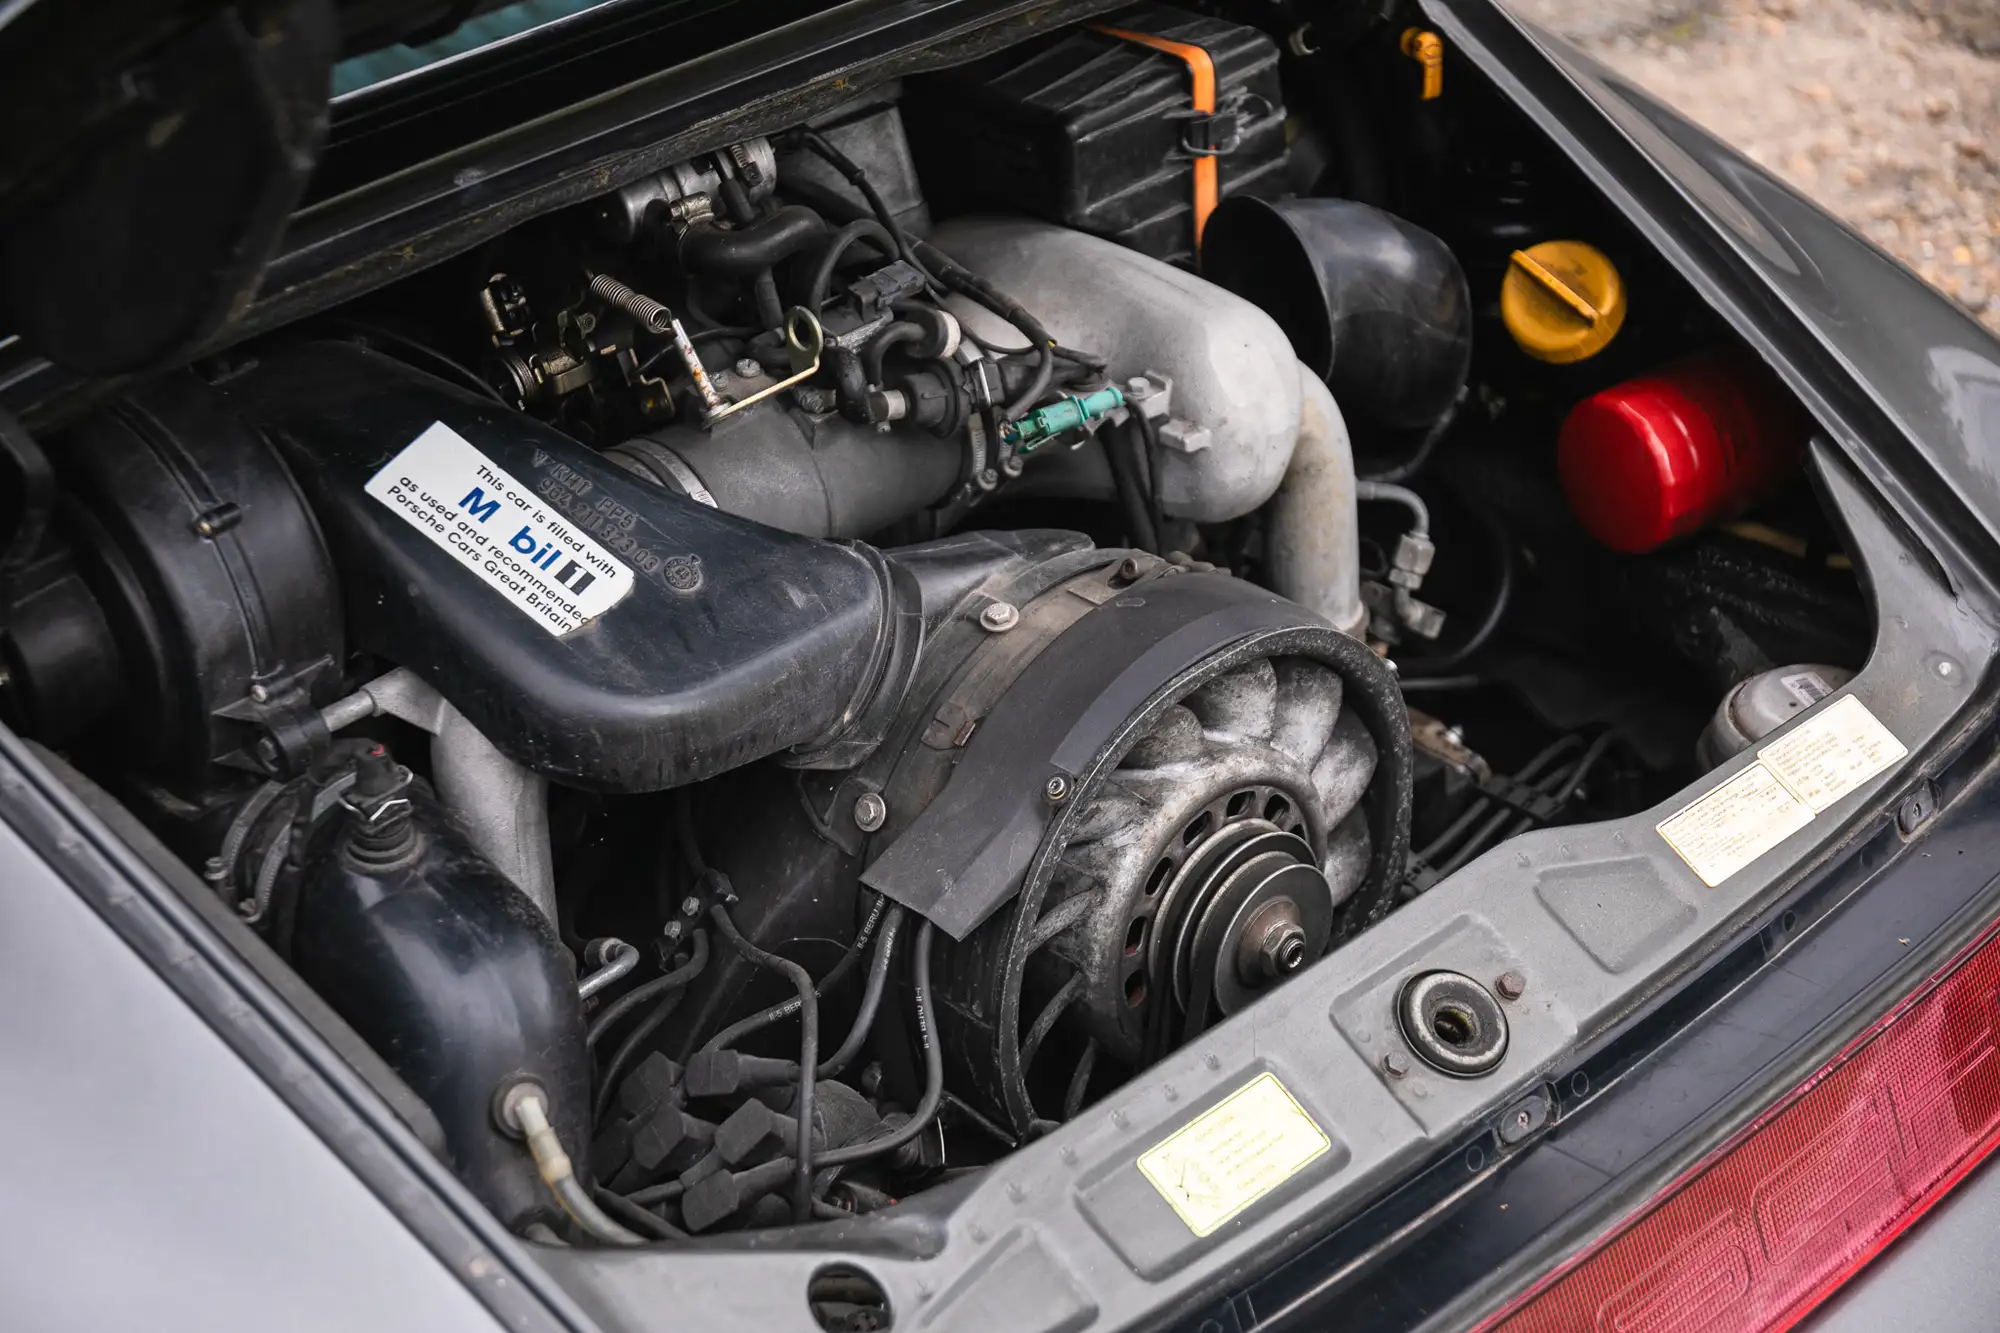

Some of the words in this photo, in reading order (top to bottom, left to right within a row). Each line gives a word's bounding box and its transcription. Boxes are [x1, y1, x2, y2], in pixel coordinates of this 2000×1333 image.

[399, 476, 419, 493] as
[420, 491, 458, 521] used
[458, 520, 488, 546] and
[538, 478, 571, 508] 964
[476, 465, 505, 494] This
[506, 487, 532, 512] car
[532, 503, 547, 524] is
[546, 521, 583, 552] filled
[585, 552, 616, 579] with
[387, 487, 445, 533] Porsche
[447, 531, 480, 561] Cars
[484, 561, 526, 597] Great
[526, 594, 573, 632] Britain
[864, 908, 880, 934] BERU
[783, 1000, 802, 1013] BER
